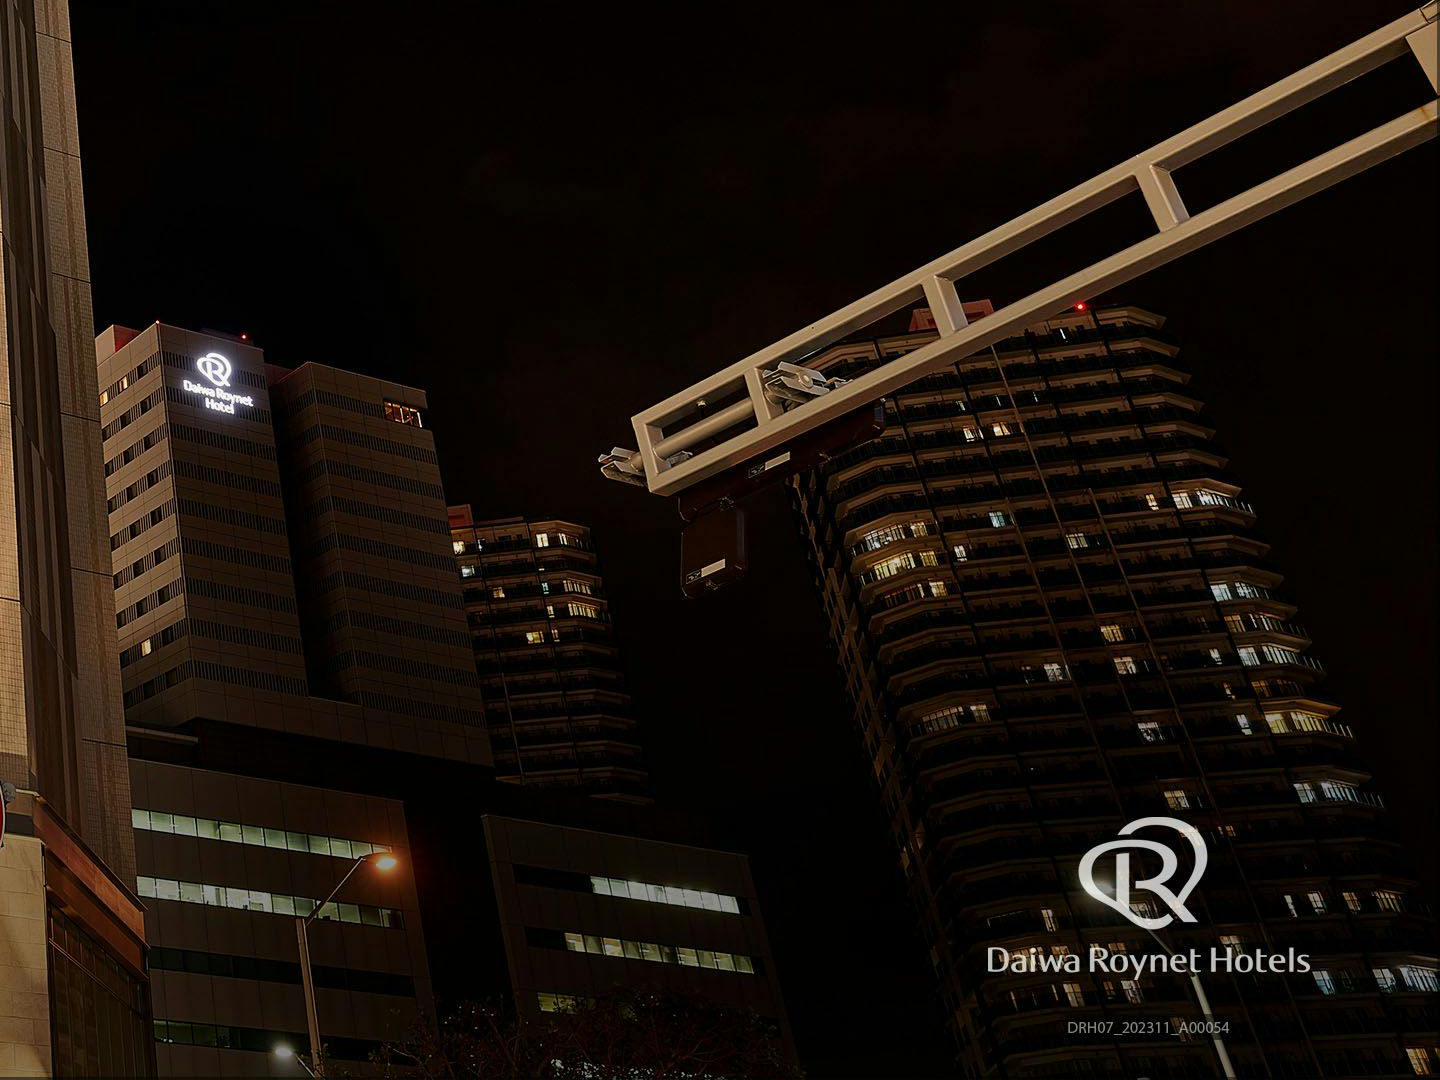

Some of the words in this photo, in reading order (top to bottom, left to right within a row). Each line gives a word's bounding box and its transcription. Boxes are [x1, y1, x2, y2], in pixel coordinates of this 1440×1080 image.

[183, 379, 216, 398] Daiwa
[215, 387, 254, 407] Roynet
[205, 397, 235, 415] Hotel
